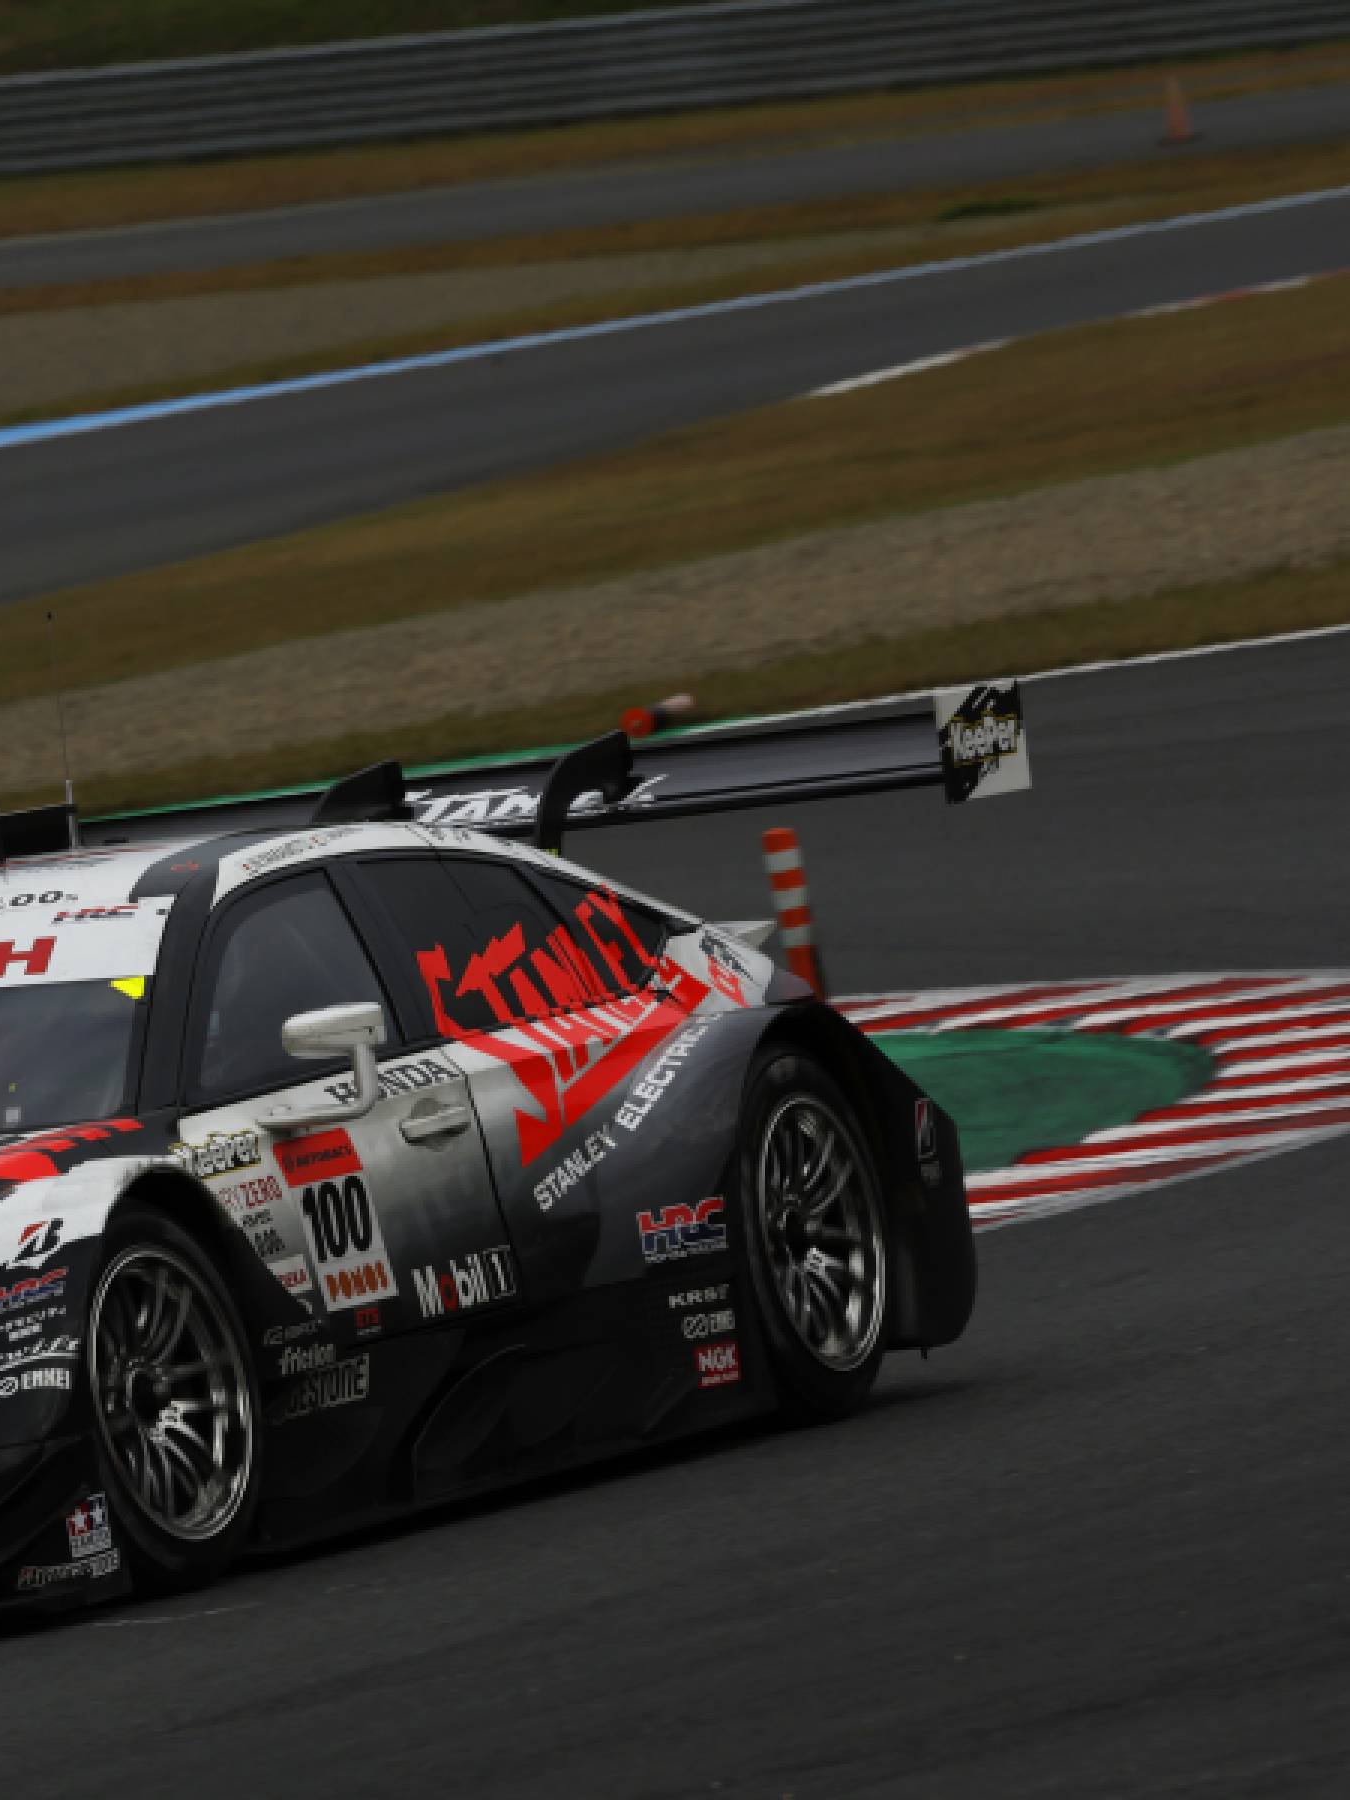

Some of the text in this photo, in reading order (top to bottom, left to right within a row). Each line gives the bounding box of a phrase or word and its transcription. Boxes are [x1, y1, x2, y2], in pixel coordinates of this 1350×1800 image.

[533, 1123, 617, 1212] STANLEY
[302, 1176, 371, 1262] 100
[636, 1196, 727, 1256] HRC
[410, 1253, 490, 1318] Mobil
[20, 1367, 71, 1390] ENKEI
[698, 1343, 738, 1373] NGK
